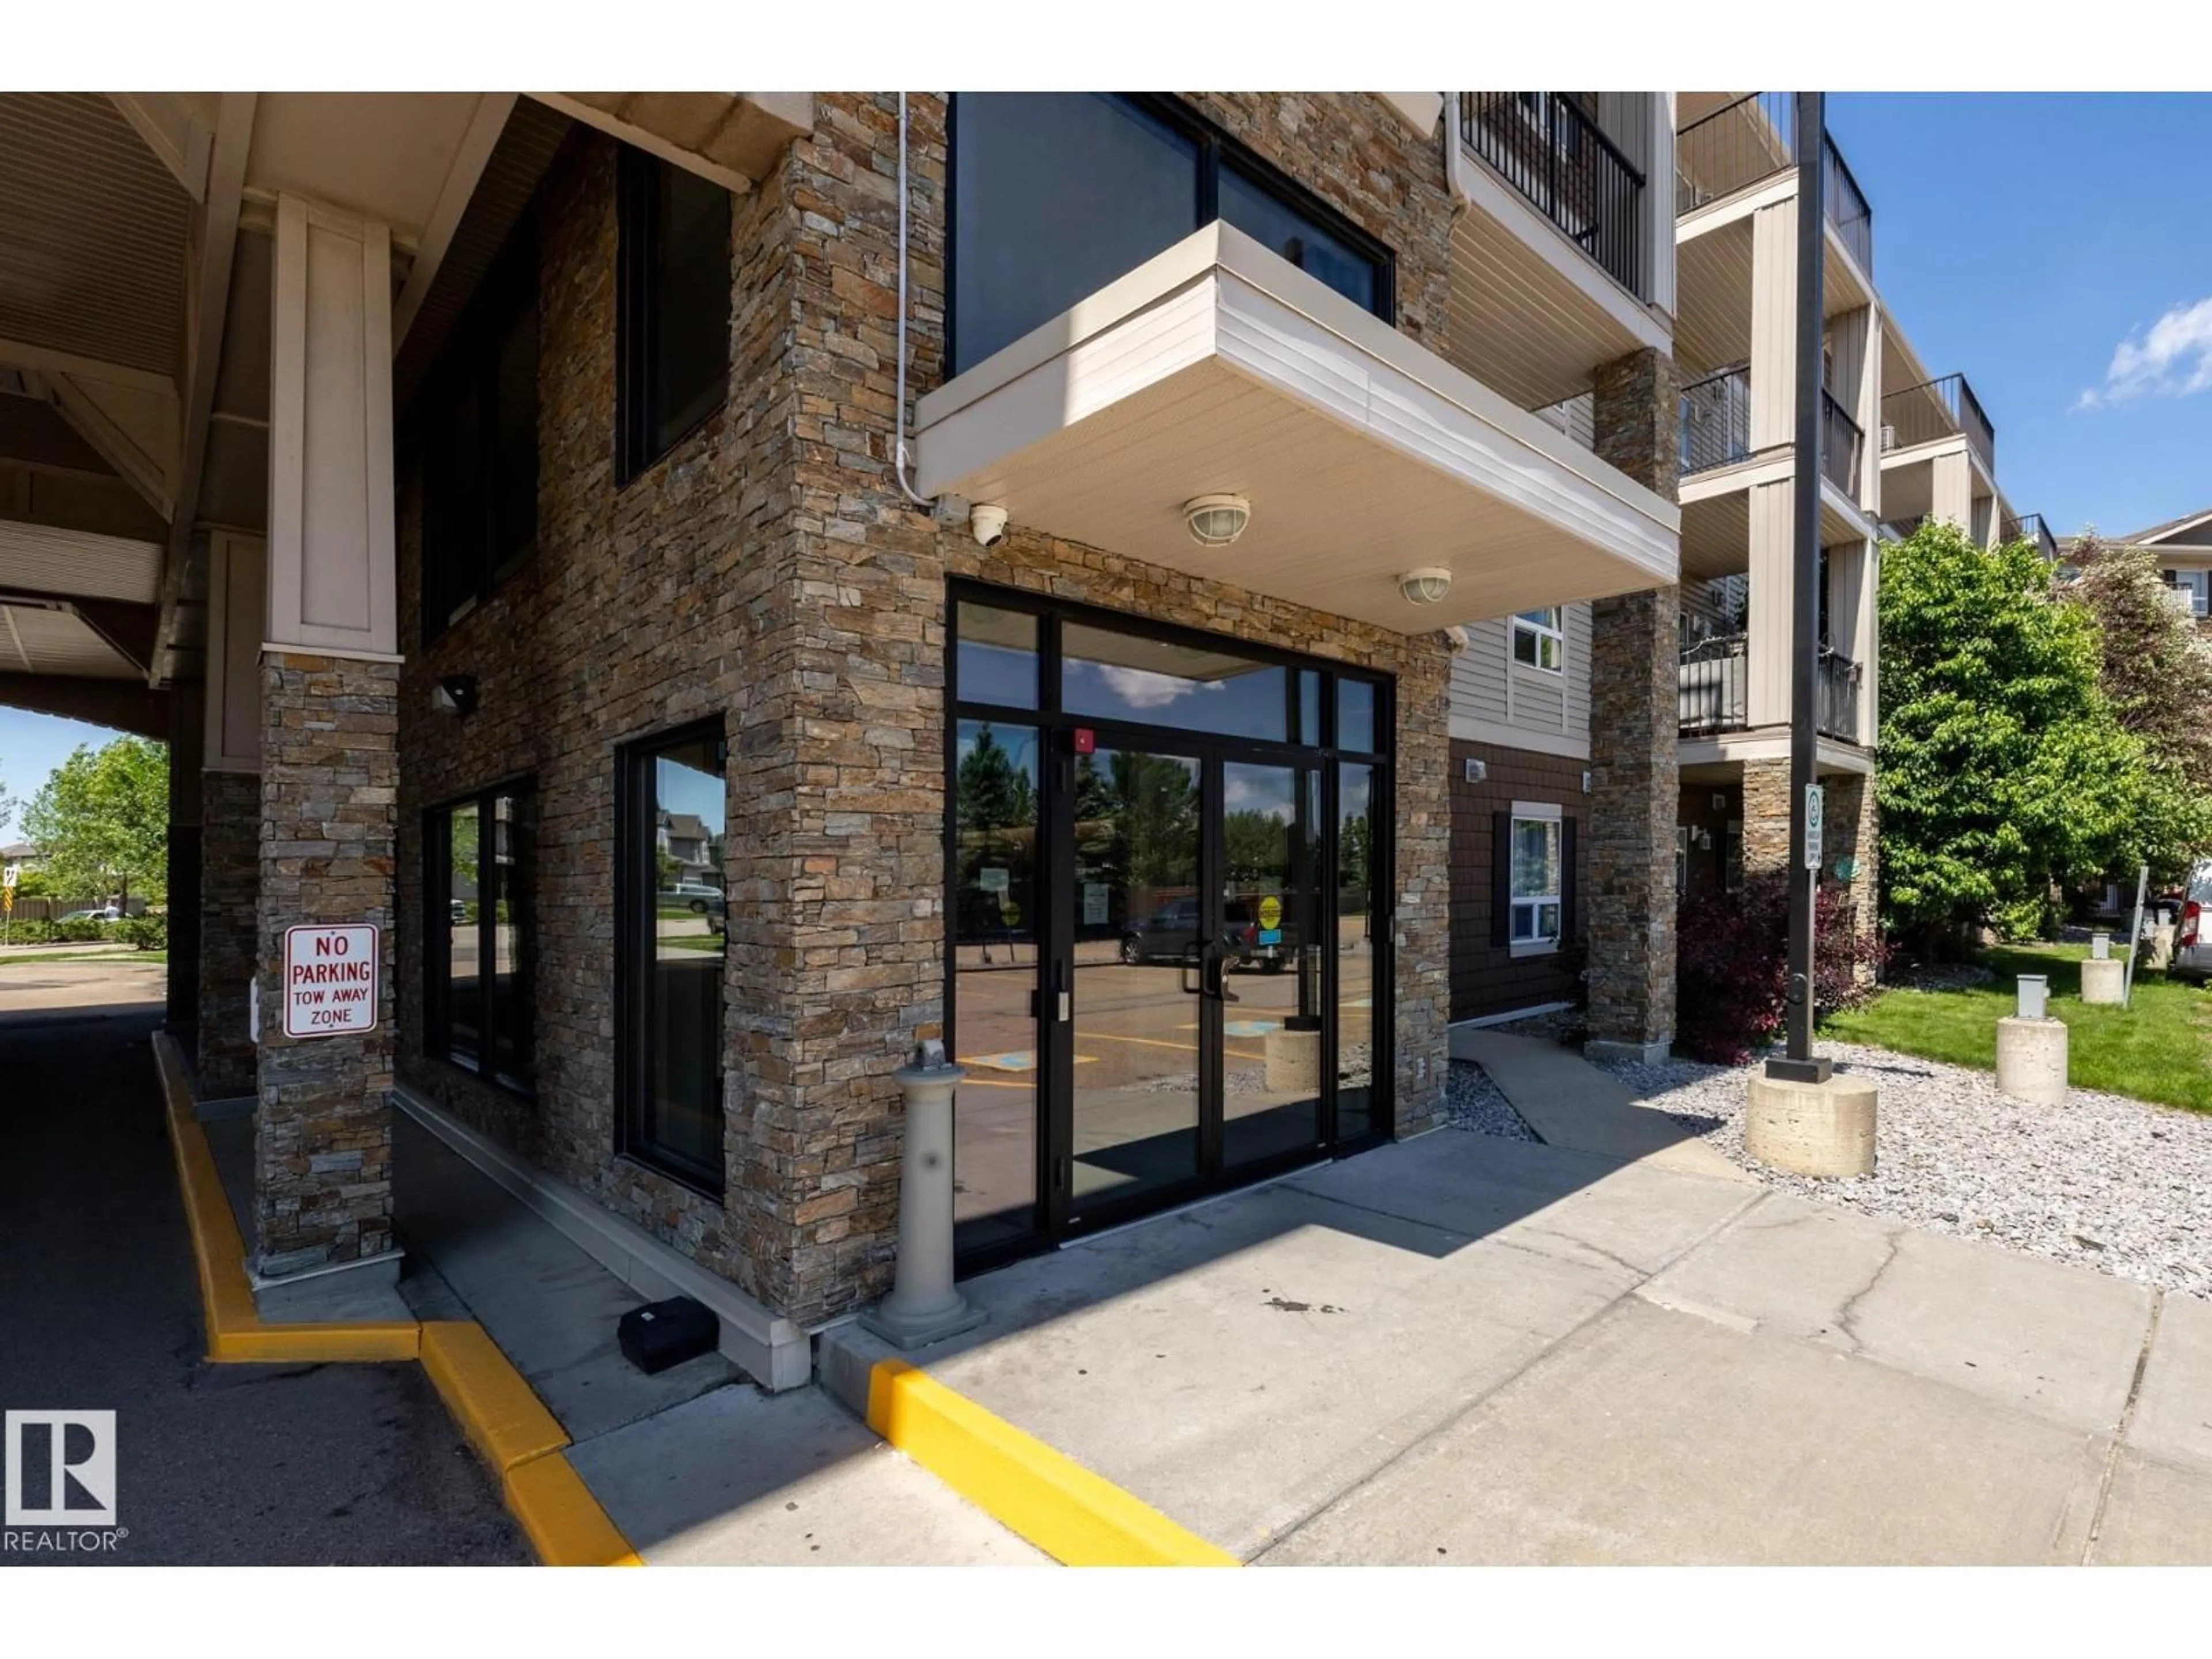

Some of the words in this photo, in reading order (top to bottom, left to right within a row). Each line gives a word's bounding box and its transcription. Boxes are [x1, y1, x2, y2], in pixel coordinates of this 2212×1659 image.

[316, 935, 348, 956] NO
[293, 961, 370, 984] PARKING
[293, 990, 324, 1005] TOW
[332, 988, 369, 1003] AWAY
[310, 1009, 352, 1025] ZONE
